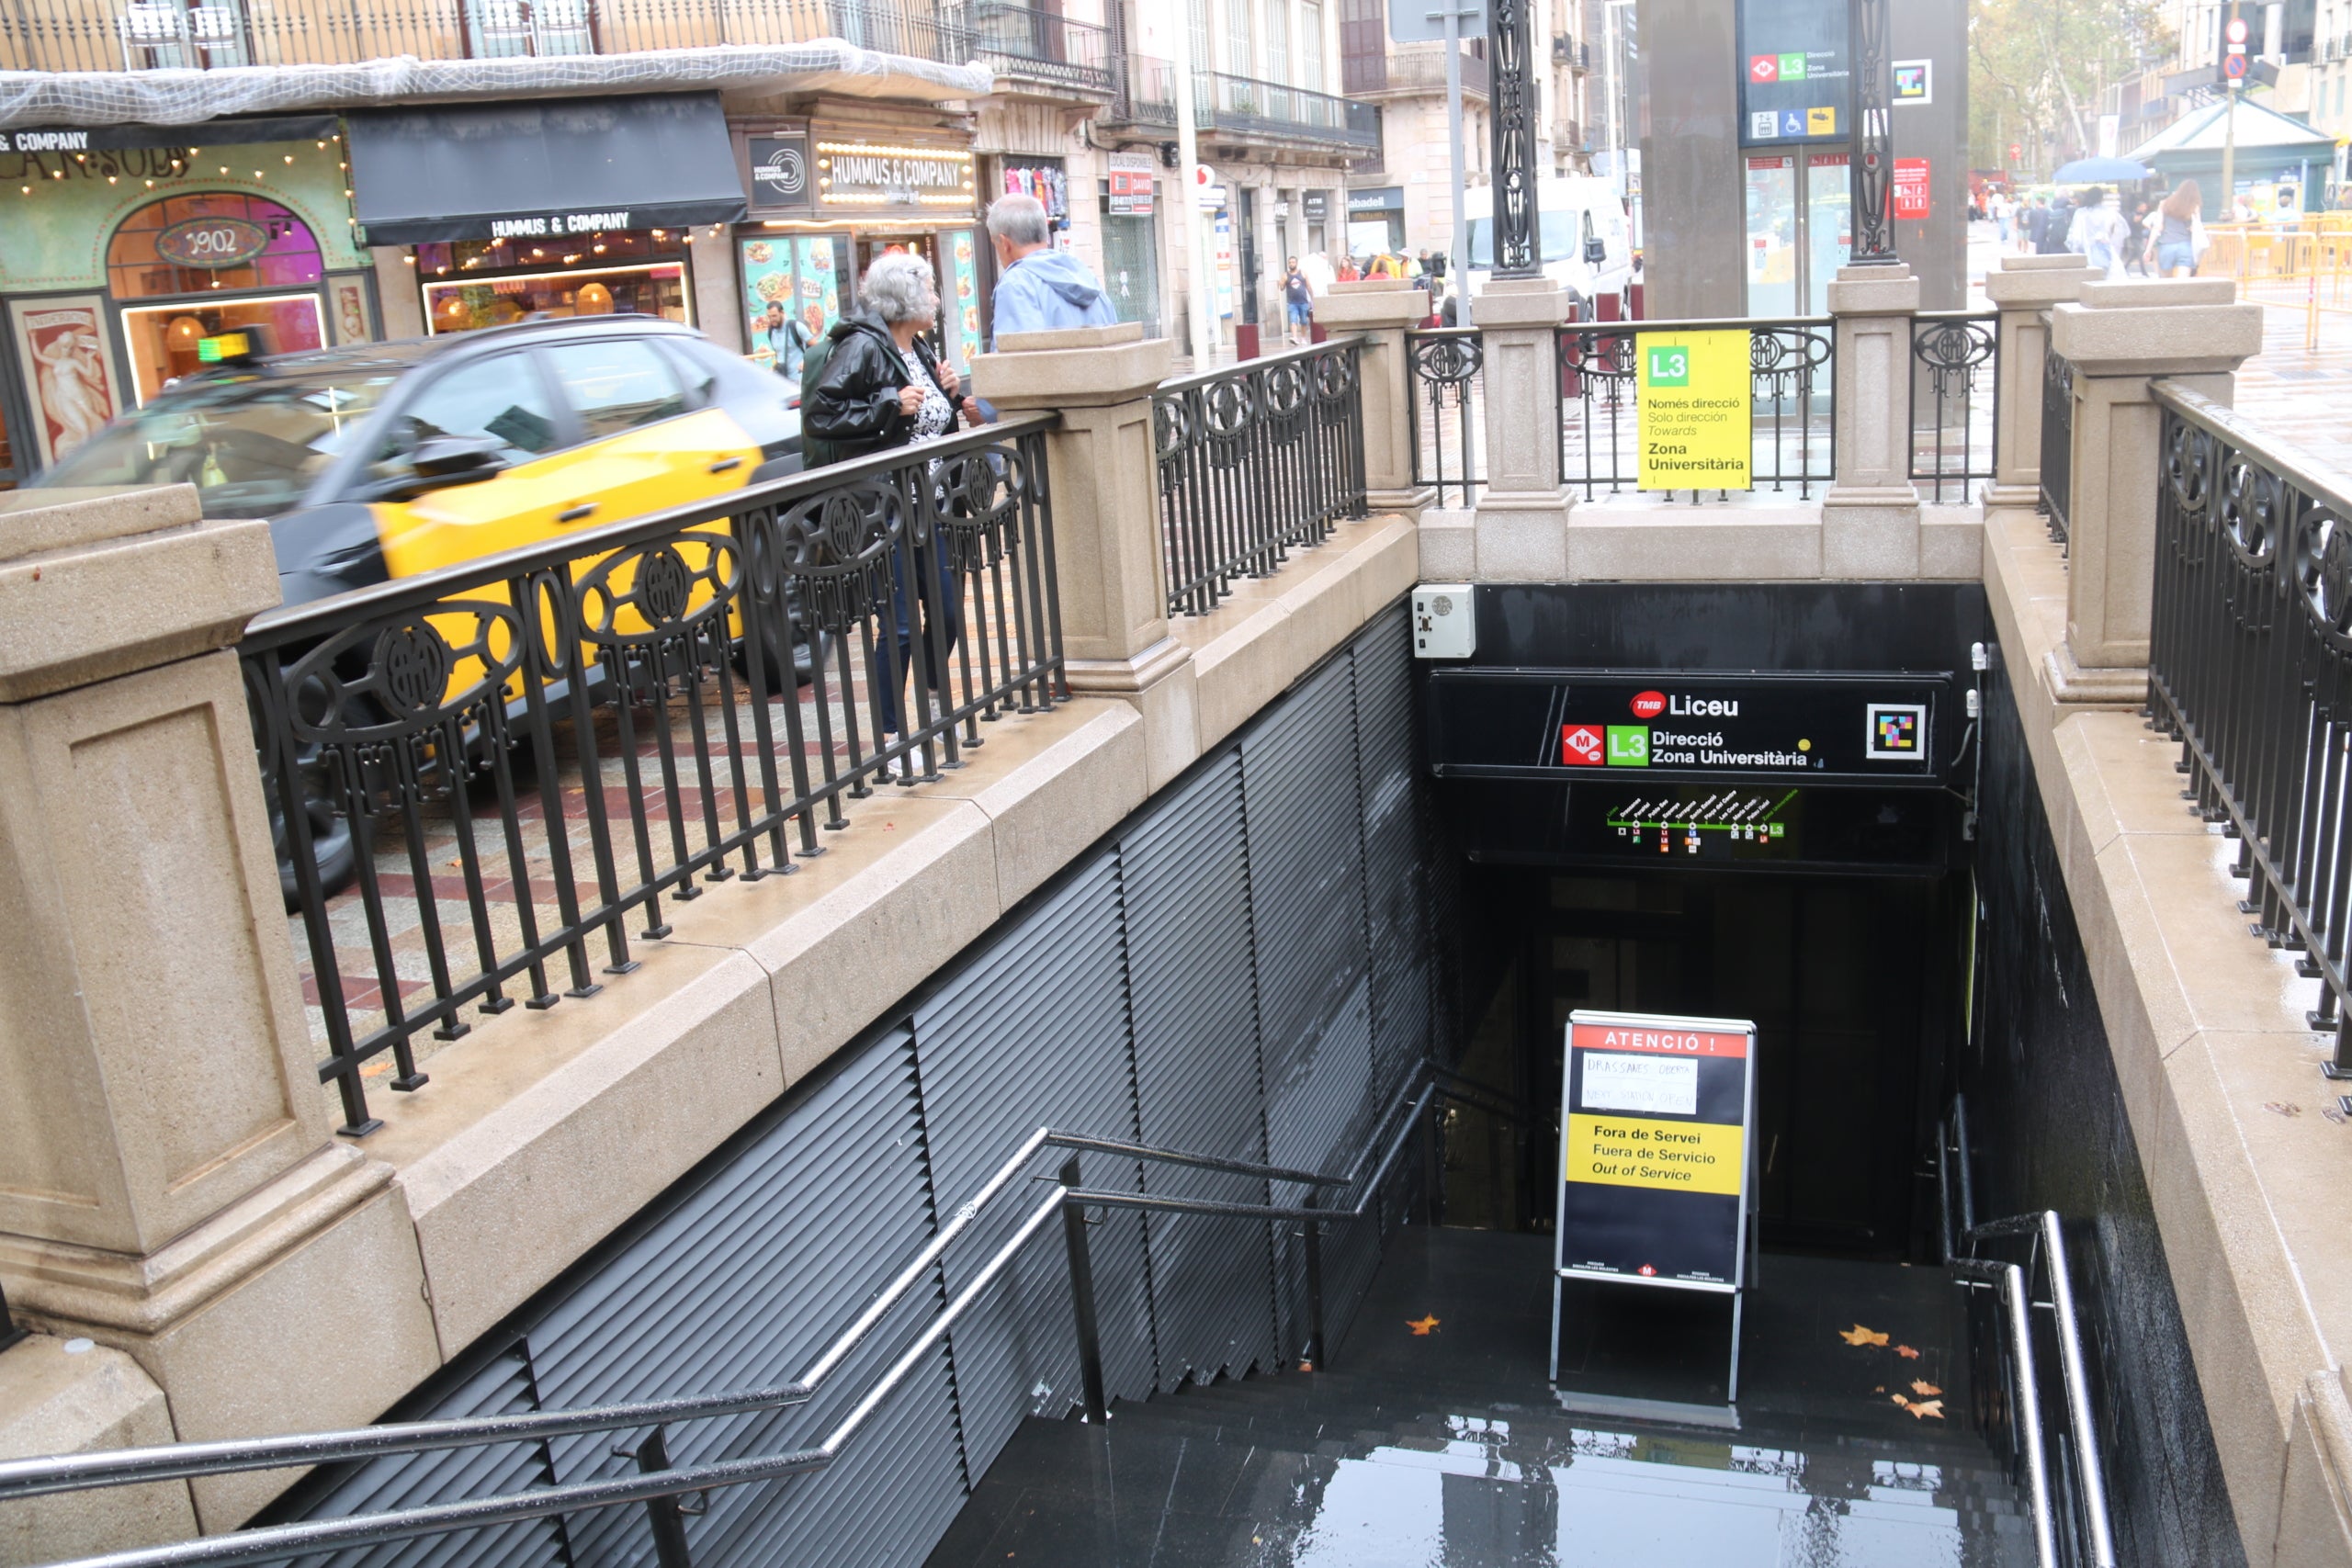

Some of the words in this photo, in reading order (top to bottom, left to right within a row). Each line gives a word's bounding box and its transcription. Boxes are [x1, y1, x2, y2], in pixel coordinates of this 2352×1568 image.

[1780, 58, 1803, 75] L3
[16, 131, 88, 152] COMPANY
[753, 165, 782, 175] HUMMUS
[754, 173, 760, 181] &
[760, 172, 789, 181] COMPANY
[831, 155, 888, 185] HUMMUS
[893, 158, 901, 185] &
[904, 159, 959, 186] COMPANY
[1133, 178, 1151, 191] DAVID
[1347, 196, 1385, 209] abadell
[491, 218, 546, 238] HUMMUS
[550, 216, 562, 233] &
[567, 211, 629, 232] COMPANY
[185, 229, 238, 254] 1902
[1652, 353, 1686, 378] L3
[1648, 399, 1690, 409] Només
[1691, 398, 1740, 409] direcció
[1648, 412, 1673, 423] Solo
[1676, 412, 1727, 423] dirección
[1649, 425, 1697, 436] Towards
[1648, 443, 1687, 455] Zona
[1649, 457, 1744, 470] Universitària
[1636, 699, 1662, 710] TMB
[1669, 694, 1738, 716] Liceu
[1576, 736, 1590, 747] M
[1611, 734, 1646, 758] L3
[1653, 732, 1724, 747] Direcció
[1652, 749, 1695, 764] Zona
[1701, 750, 1807, 766] Universitària
[1770, 825, 1783, 834] L3
[1605, 1031, 1699, 1051] ATENCIÓ
[1709, 1038, 1715, 1052] !
[1588, 1058, 1649, 1075] DRASSANES
[1587, 1089, 1611, 1100] NEXT
[1659, 1093, 1693, 1107] OPEN
[1594, 1125, 1626, 1139] Fora
[1631, 1128, 1649, 1140] de
[1654, 1130, 1701, 1145] Servei
[1592, 1144, 1633, 1158] Fuera
[1636, 1146, 1654, 1160] de
[1658, 1149, 1715, 1165] Servicio
[1592, 1162, 1617, 1176] Out
[1622, 1164, 1636, 1177] of
[1639, 1166, 1691, 1181] Service
[1643, 1266, 1652, 1276] M
